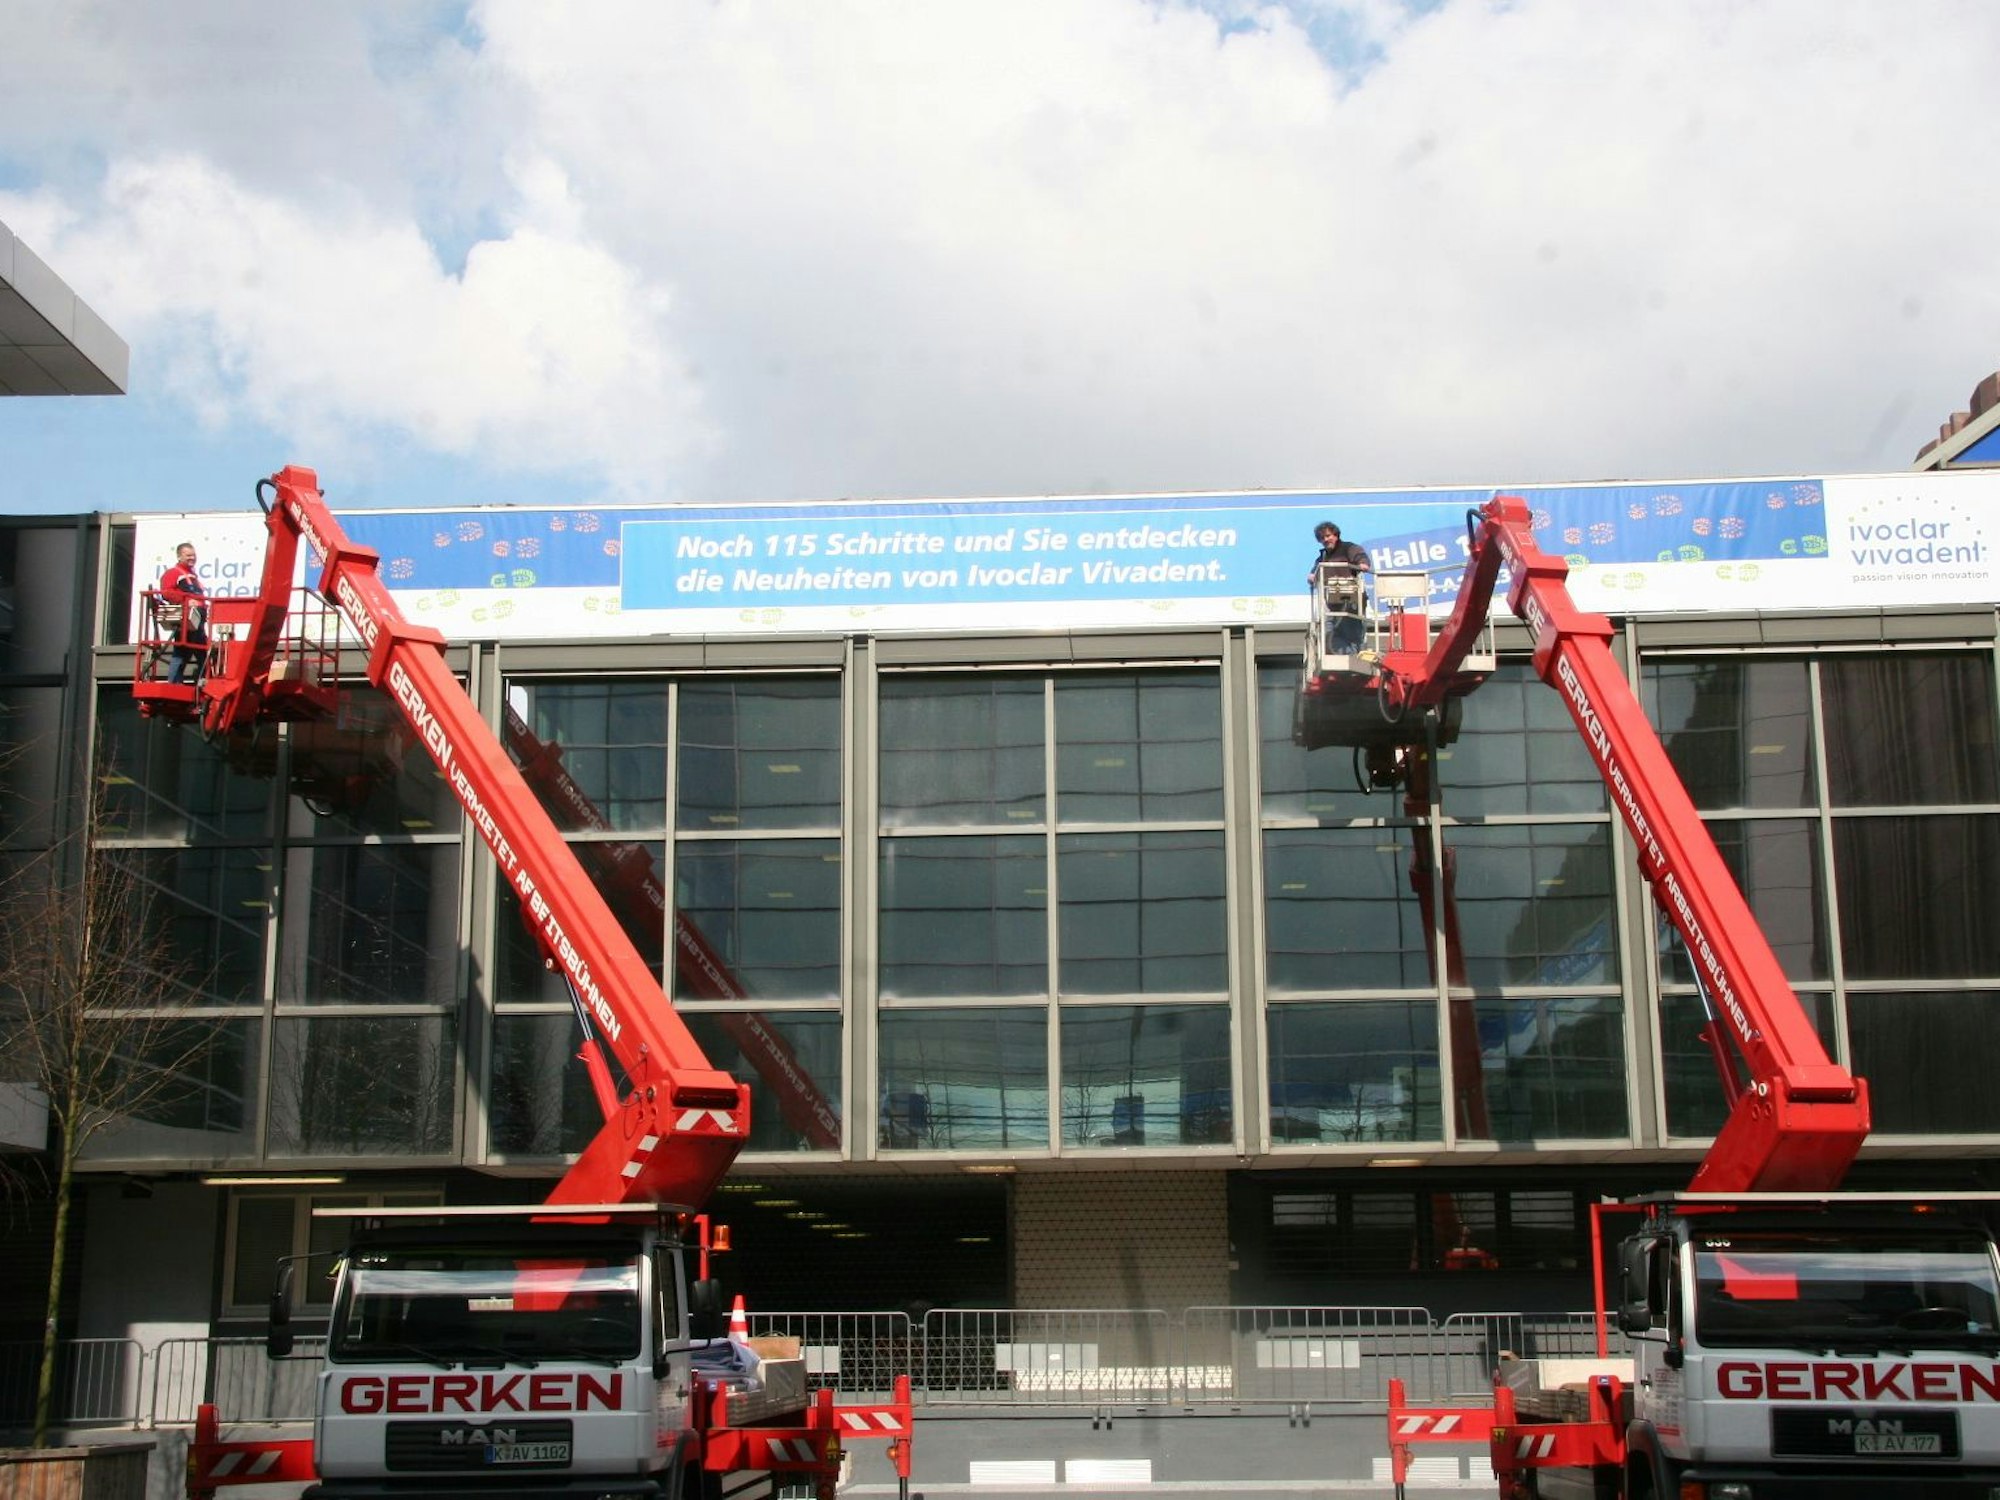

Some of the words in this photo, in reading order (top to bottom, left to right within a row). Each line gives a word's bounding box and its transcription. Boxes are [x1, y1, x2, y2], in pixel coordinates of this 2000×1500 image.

[676, 534, 754, 558] Noch
[765, 534, 818, 556] 115
[825, 531, 945, 555] Schritte
[954, 528, 1015, 552] und
[1022, 527, 1068, 551] Sie
[1077, 523, 1237, 550] entdecken
[1850, 518, 1950, 541] ivoclar
[1371, 540, 1446, 570] Halle
[1851, 541, 1980, 565] vivadent
[156, 558, 252, 580] iclar
[676, 568, 724, 592] die
[733, 567, 892, 592] Neuheiten
[902, 570, 958, 588] von
[967, 562, 1072, 587] Ivoclar
[1082, 559, 1228, 585] Vivadent.
[1853, 574, 1893, 584] passion
[1898, 572, 1928, 581] vision
[1932, 570, 1990, 580] innovation
[336, 575, 379, 649] GERKE
[389, 661, 453, 769] GERKEN
[450, 761, 518, 872] VERMIETET
[1556, 653, 1612, 762] GERKEN
[1608, 757, 1666, 869] VERMIETET
[1664, 871, 1754, 1043] ARBEITSBÜHNEN
[341, 1373, 623, 1414] GERKEN
[1717, 1361, 2000, 1401] GERKEN
[440, 1428, 517, 1445] MAN
[1828, 1418, 1904, 1436] MAN
[512, 1446, 531, 1460] AV
